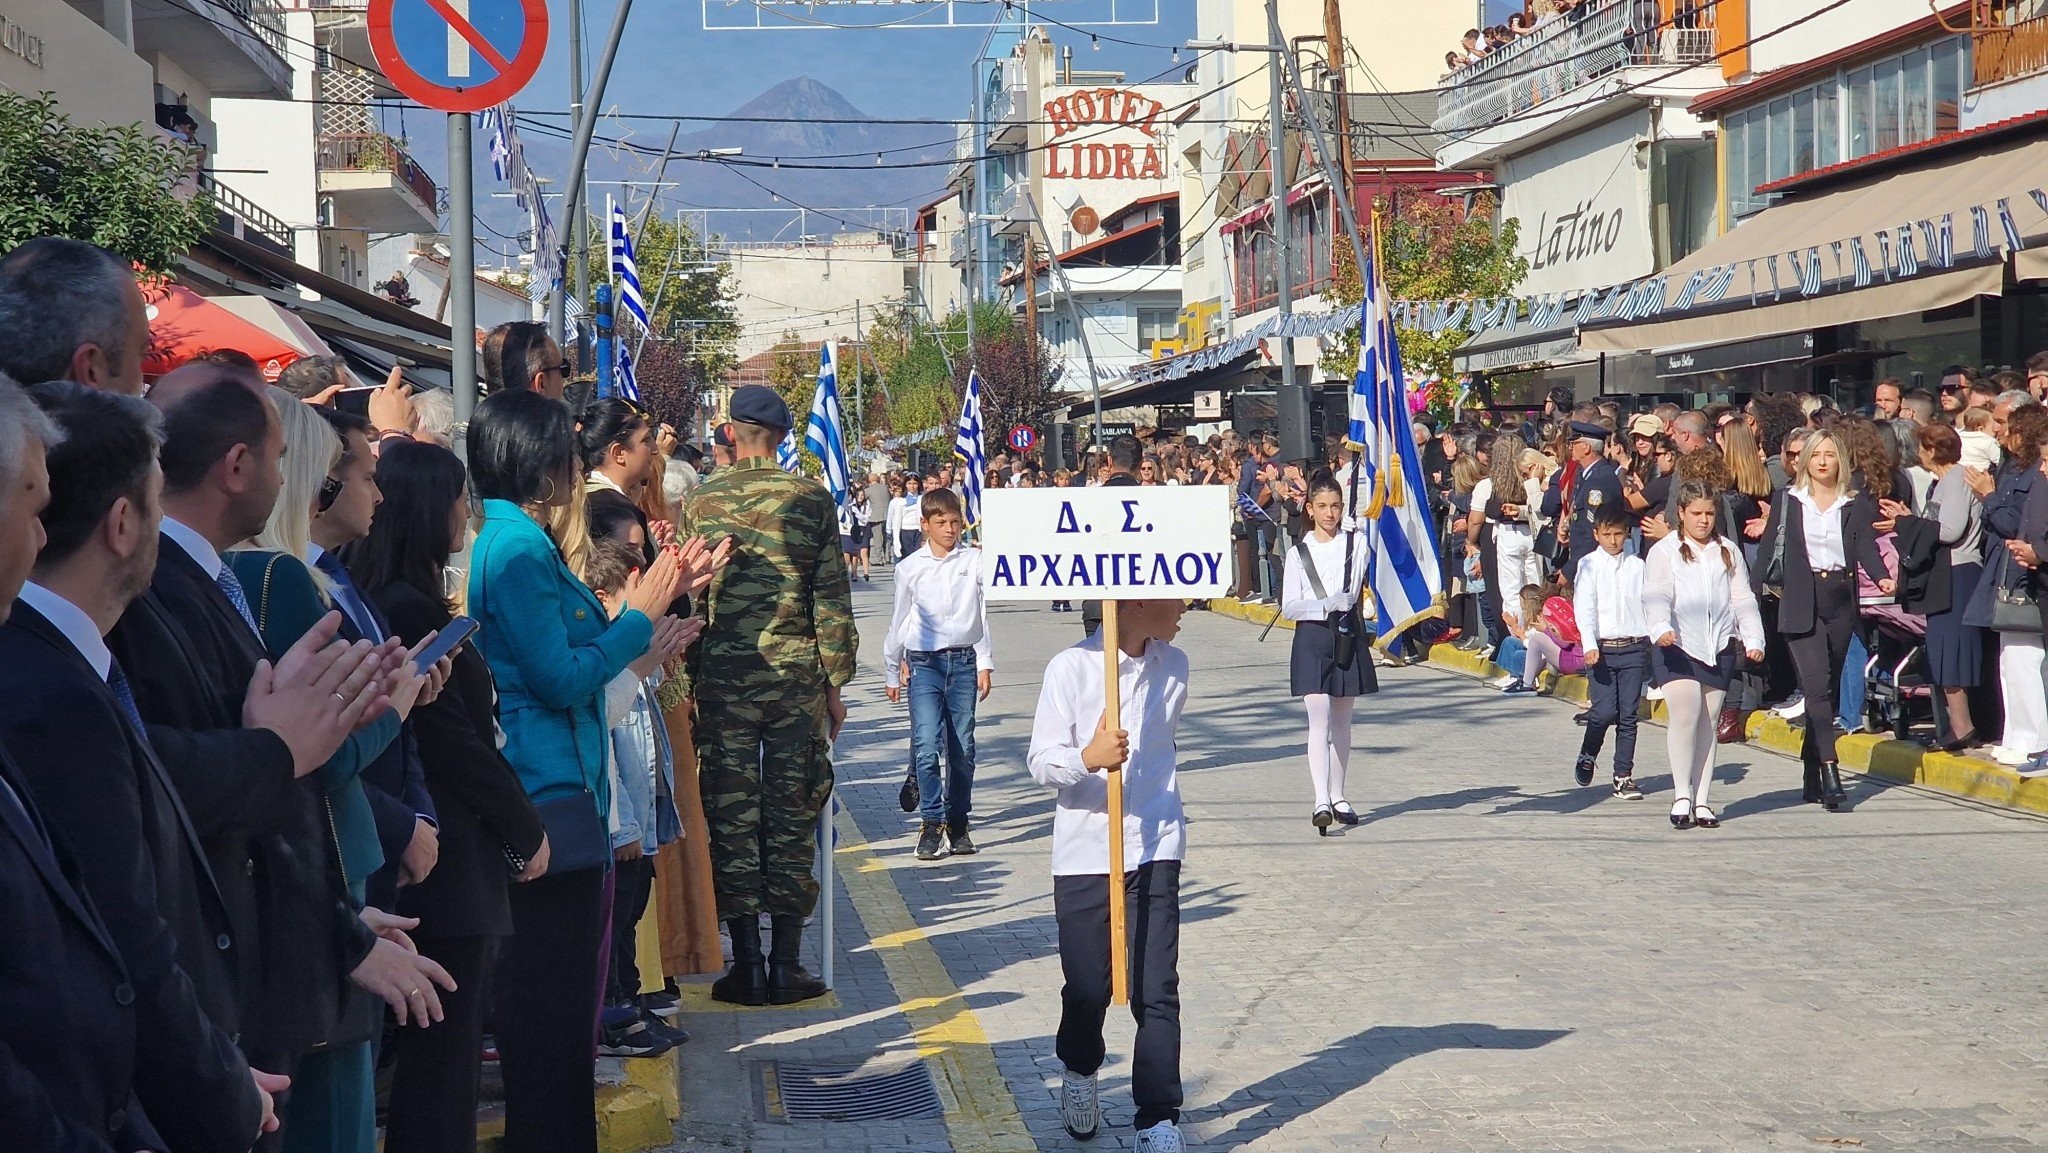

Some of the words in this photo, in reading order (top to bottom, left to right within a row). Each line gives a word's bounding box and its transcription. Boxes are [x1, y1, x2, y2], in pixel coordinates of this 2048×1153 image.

[1043, 88, 1162, 137] HOTEL
[1048, 143, 1163, 180] LIDRA
[1532, 198, 1623, 270] Latino
[1483, 345, 1540, 368] ΠΕΙΝΑΚΟΘΗΚΗ
[1092, 427, 1133, 436] CSABLANCA
[1056, 501, 1092, 533] Δ.
[1121, 500, 1154, 532] Σ.
[991, 552, 1223, 586] ΑΡΧΑΓΓΕΛΟΥ
